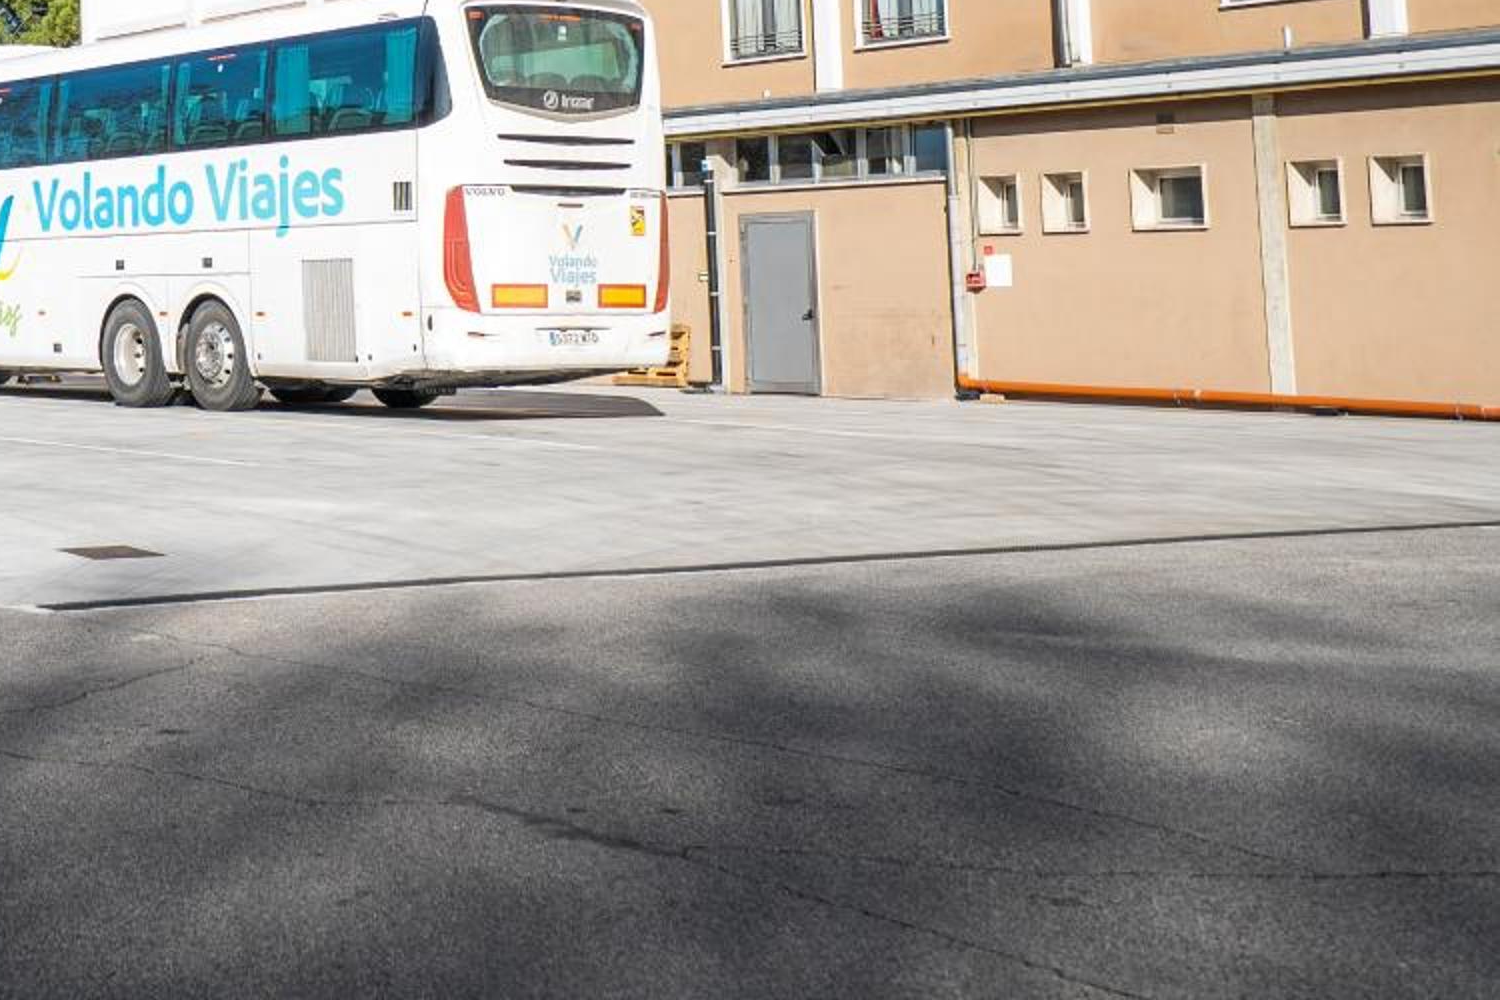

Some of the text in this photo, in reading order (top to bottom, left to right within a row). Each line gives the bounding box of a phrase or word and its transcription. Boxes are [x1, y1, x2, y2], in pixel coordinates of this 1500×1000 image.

[32, 155, 345, 238] Volando Viajes
[549, 253, 598, 268] Volando
[549, 267, 597, 287] Viajes
